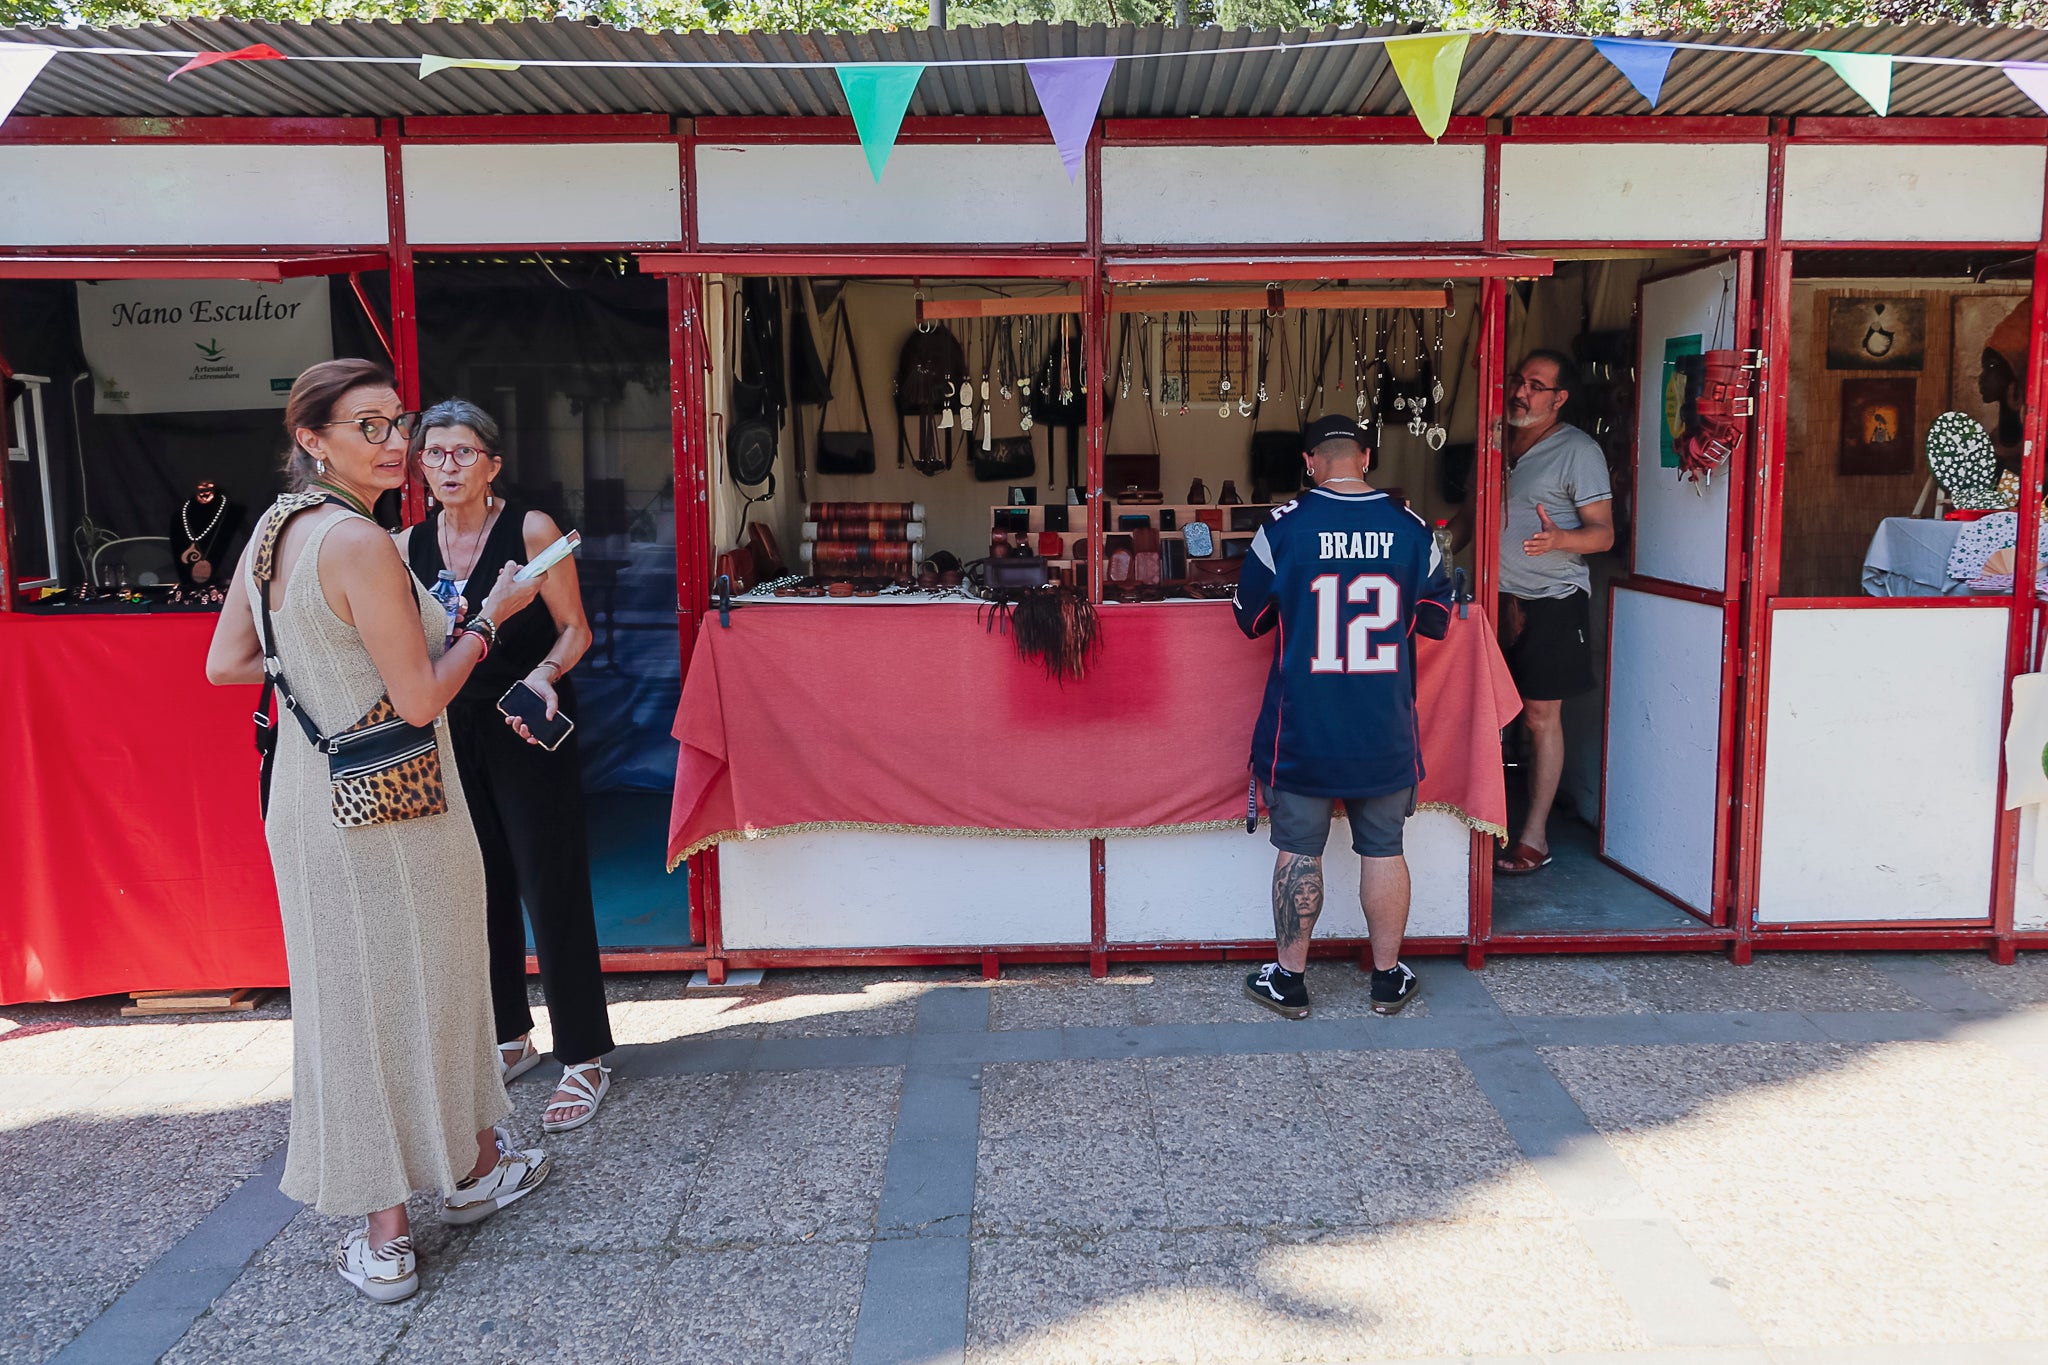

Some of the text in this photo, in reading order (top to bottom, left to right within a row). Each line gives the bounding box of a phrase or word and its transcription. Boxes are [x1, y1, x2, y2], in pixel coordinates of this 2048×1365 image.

[112, 295, 301, 327] Nano Escultor
[1318, 532, 1394, 560] BRADY
[1310, 573, 1400, 674] 12
